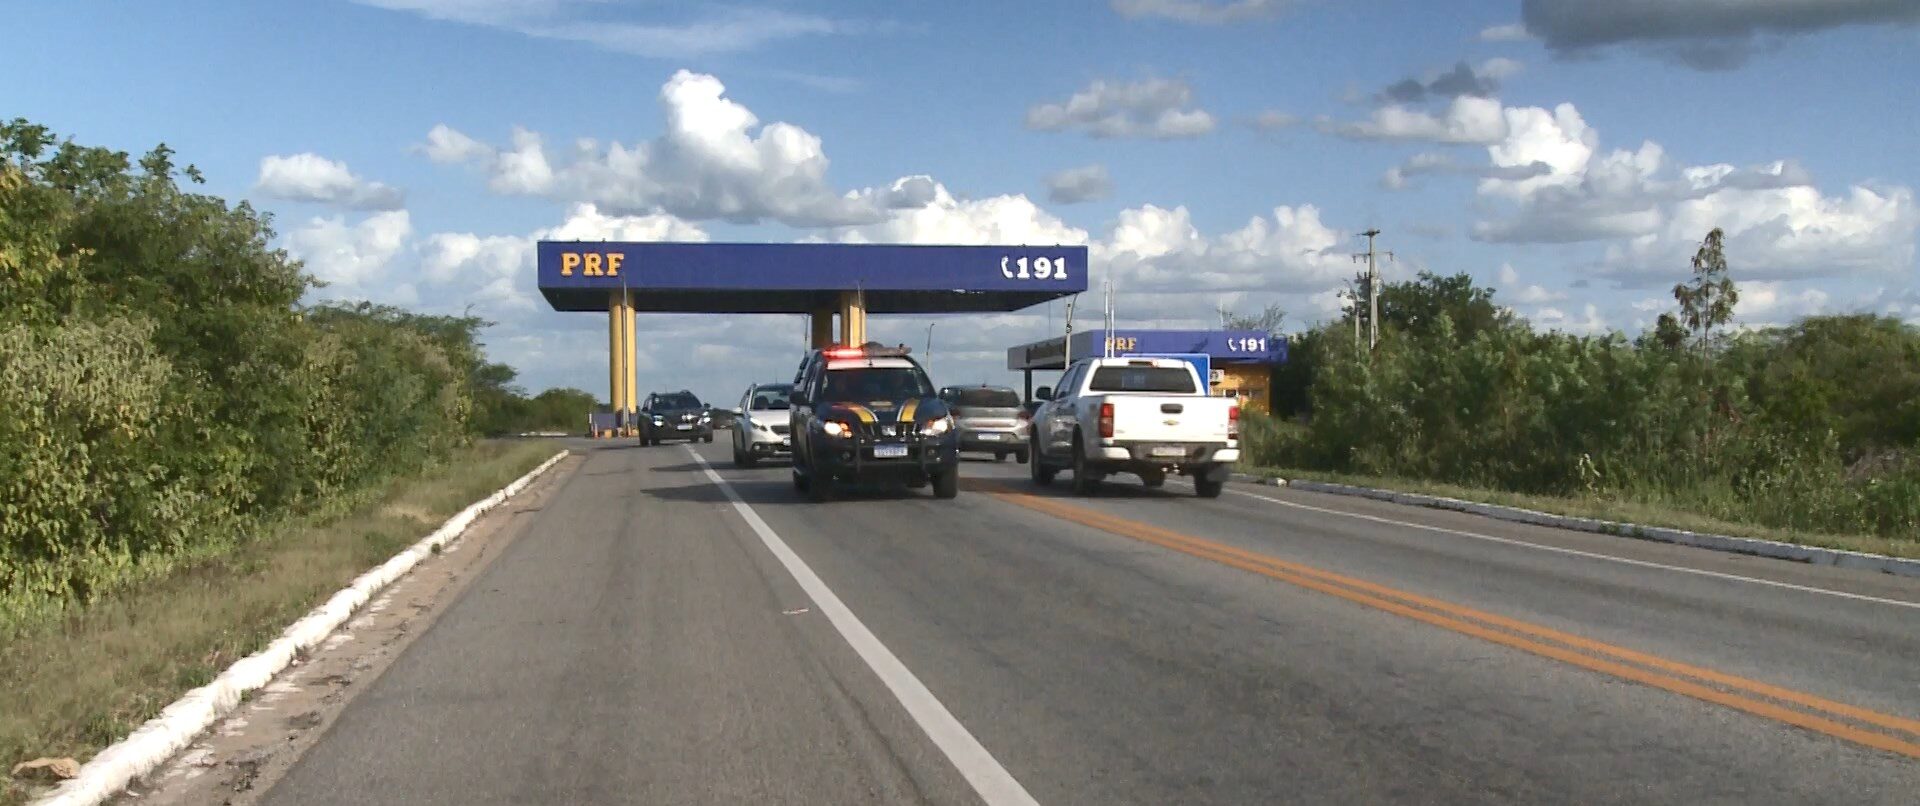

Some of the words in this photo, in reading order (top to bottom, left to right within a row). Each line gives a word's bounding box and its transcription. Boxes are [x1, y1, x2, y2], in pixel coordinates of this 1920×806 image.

[561, 253, 625, 276] PRF
[1016, 257, 1068, 279] 191
[1239, 337, 1265, 351] 191
